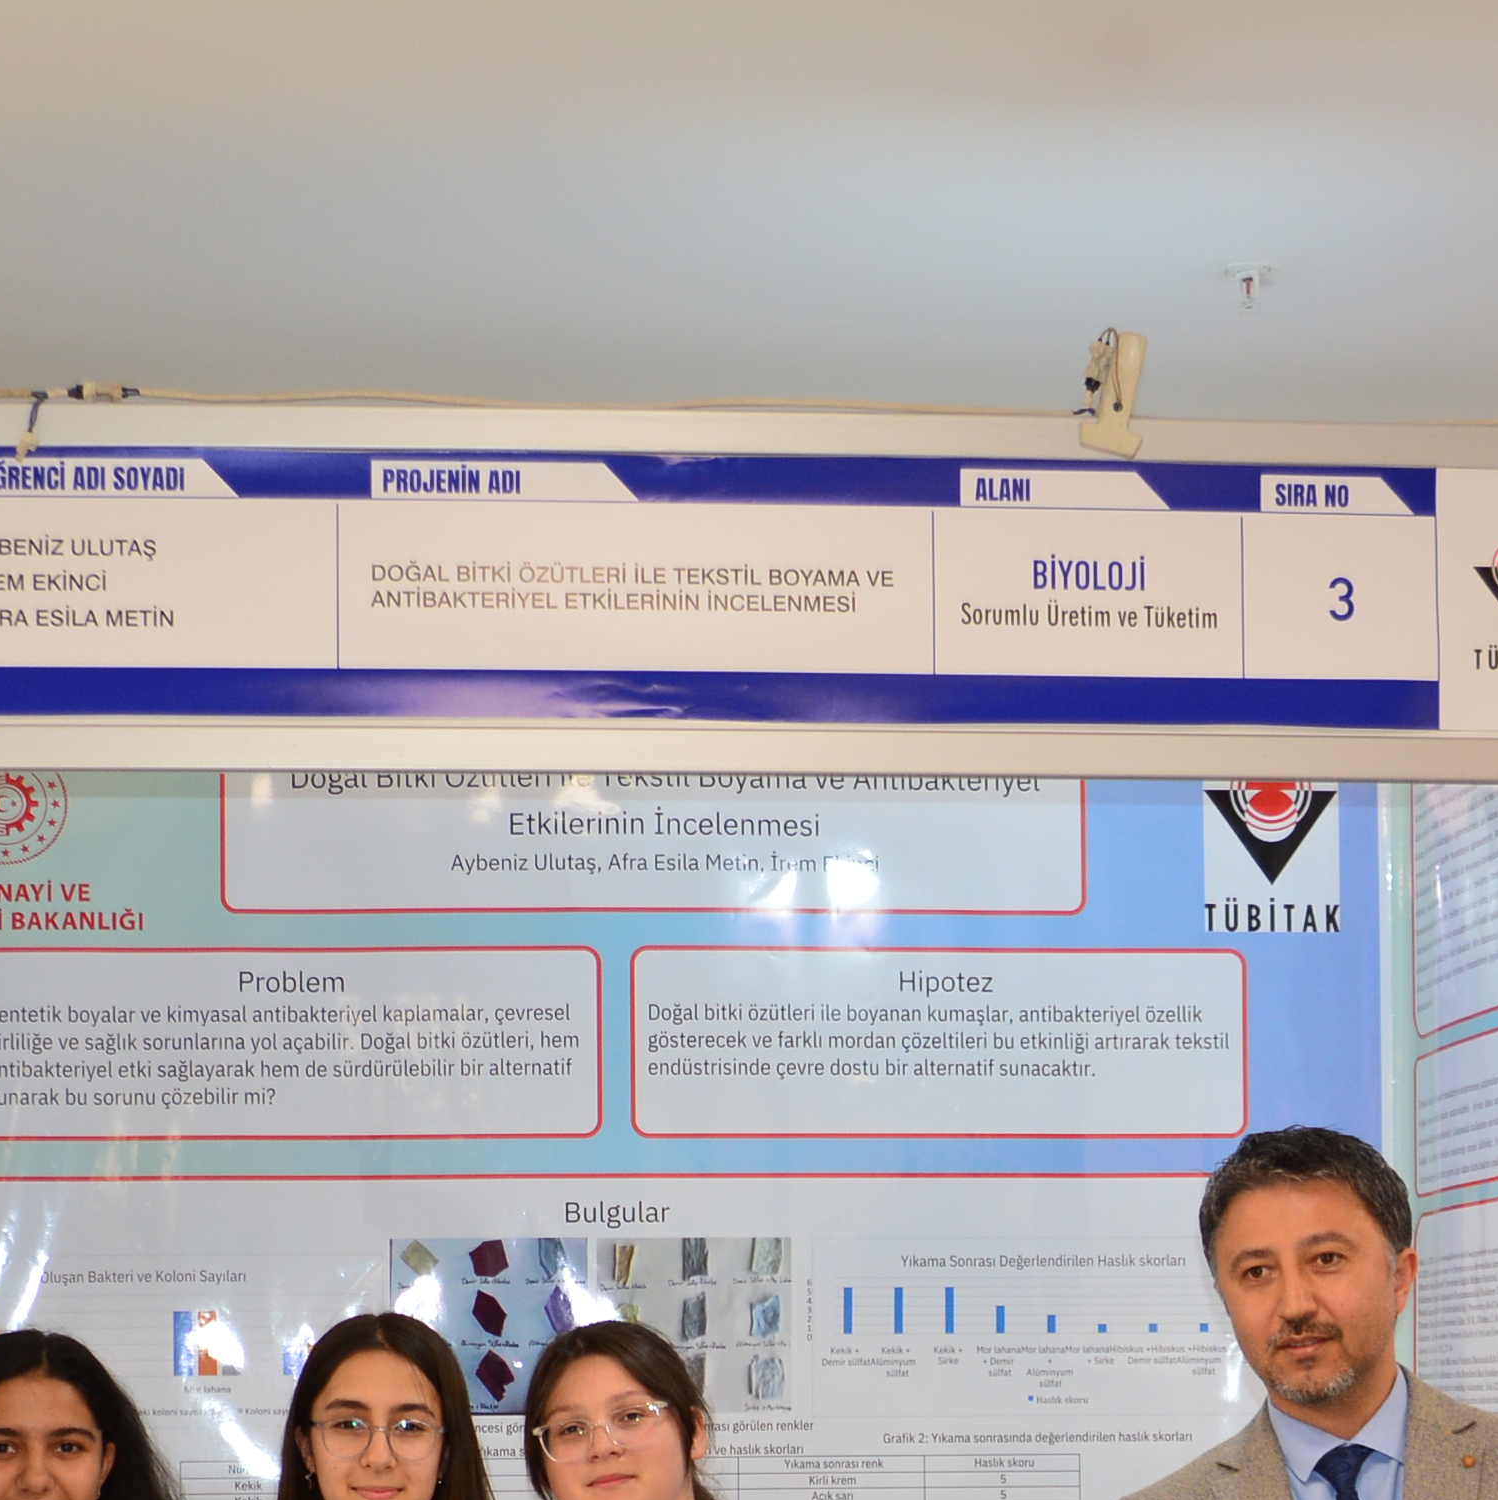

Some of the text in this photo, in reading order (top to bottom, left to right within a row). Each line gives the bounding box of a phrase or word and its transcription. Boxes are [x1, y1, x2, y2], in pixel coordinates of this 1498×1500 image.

[73, 466, 105, 490] ADI
[114, 467, 184, 491] SOYADI
[383, 465, 520, 493] PROJENİN ADI
[976, 478, 1030, 501] ALANI
[1276, 484, 1348, 507] SIRA NO
[71, 539, 156, 561] ULUTAŞ
[33, 570, 106, 591] EKİNCİ
[372, 560, 894, 587] DOĞAL BİTKİ ÖZÜTLERİ İLE TEKSTİL BOYAMA VE
[1034, 554, 1144, 591] BİYOLOJİ
[371, 587, 855, 613] ANTİBAKTERİYEL ETKİLERİNİN İNCELENMESİ
[1329, 577, 1354, 621] 3
[36, 605, 98, 627] ESİLA
[106, 606, 174, 627] METİN
[961, 601, 1217, 628] Sorumlu Üretim ve Tüketim
[510, 806, 818, 836] Etkilerinin İncelenmesi
[451, 854, 528, 875] Aybeniz
[535, 853, 601, 874] Ulutaş,
[608, 853, 648, 870] Afra
[655, 853, 699, 871] Esila
[61, 884, 90, 901] VE
[12, 908, 143, 930] BAKANLIĞI
[1204, 897, 1340, 933] TÜBİTAK
[240, 971, 344, 993] Problem
[900, 970, 993, 997] Hipotez
[68, 1005, 135, 1027] boyalar
[141, 1010, 161, 1023] ve
[168, 1005, 246, 1026] kimyasal
[253, 1005, 377, 1026] antibakteriyel
[384, 1004, 488, 1026] kaplamalar,
[495, 1003, 570, 1025] çevresel
[649, 1003, 1202, 1026] Doğal bitki özütleri ile boyanan kumaşlar, antibakteriyel özellik
[566, 1201, 670, 1229] Bulgular
[901, 1254, 1185, 1270] Yıkama Sonrası Değerlendirilen Haslık skorları
[883, 1431, 1192, 1445] Grafik 2: Yıkama sonrasında değerlendirilen haslık skorları
[974, 1457, 1035, 1468] Haslık skoru
